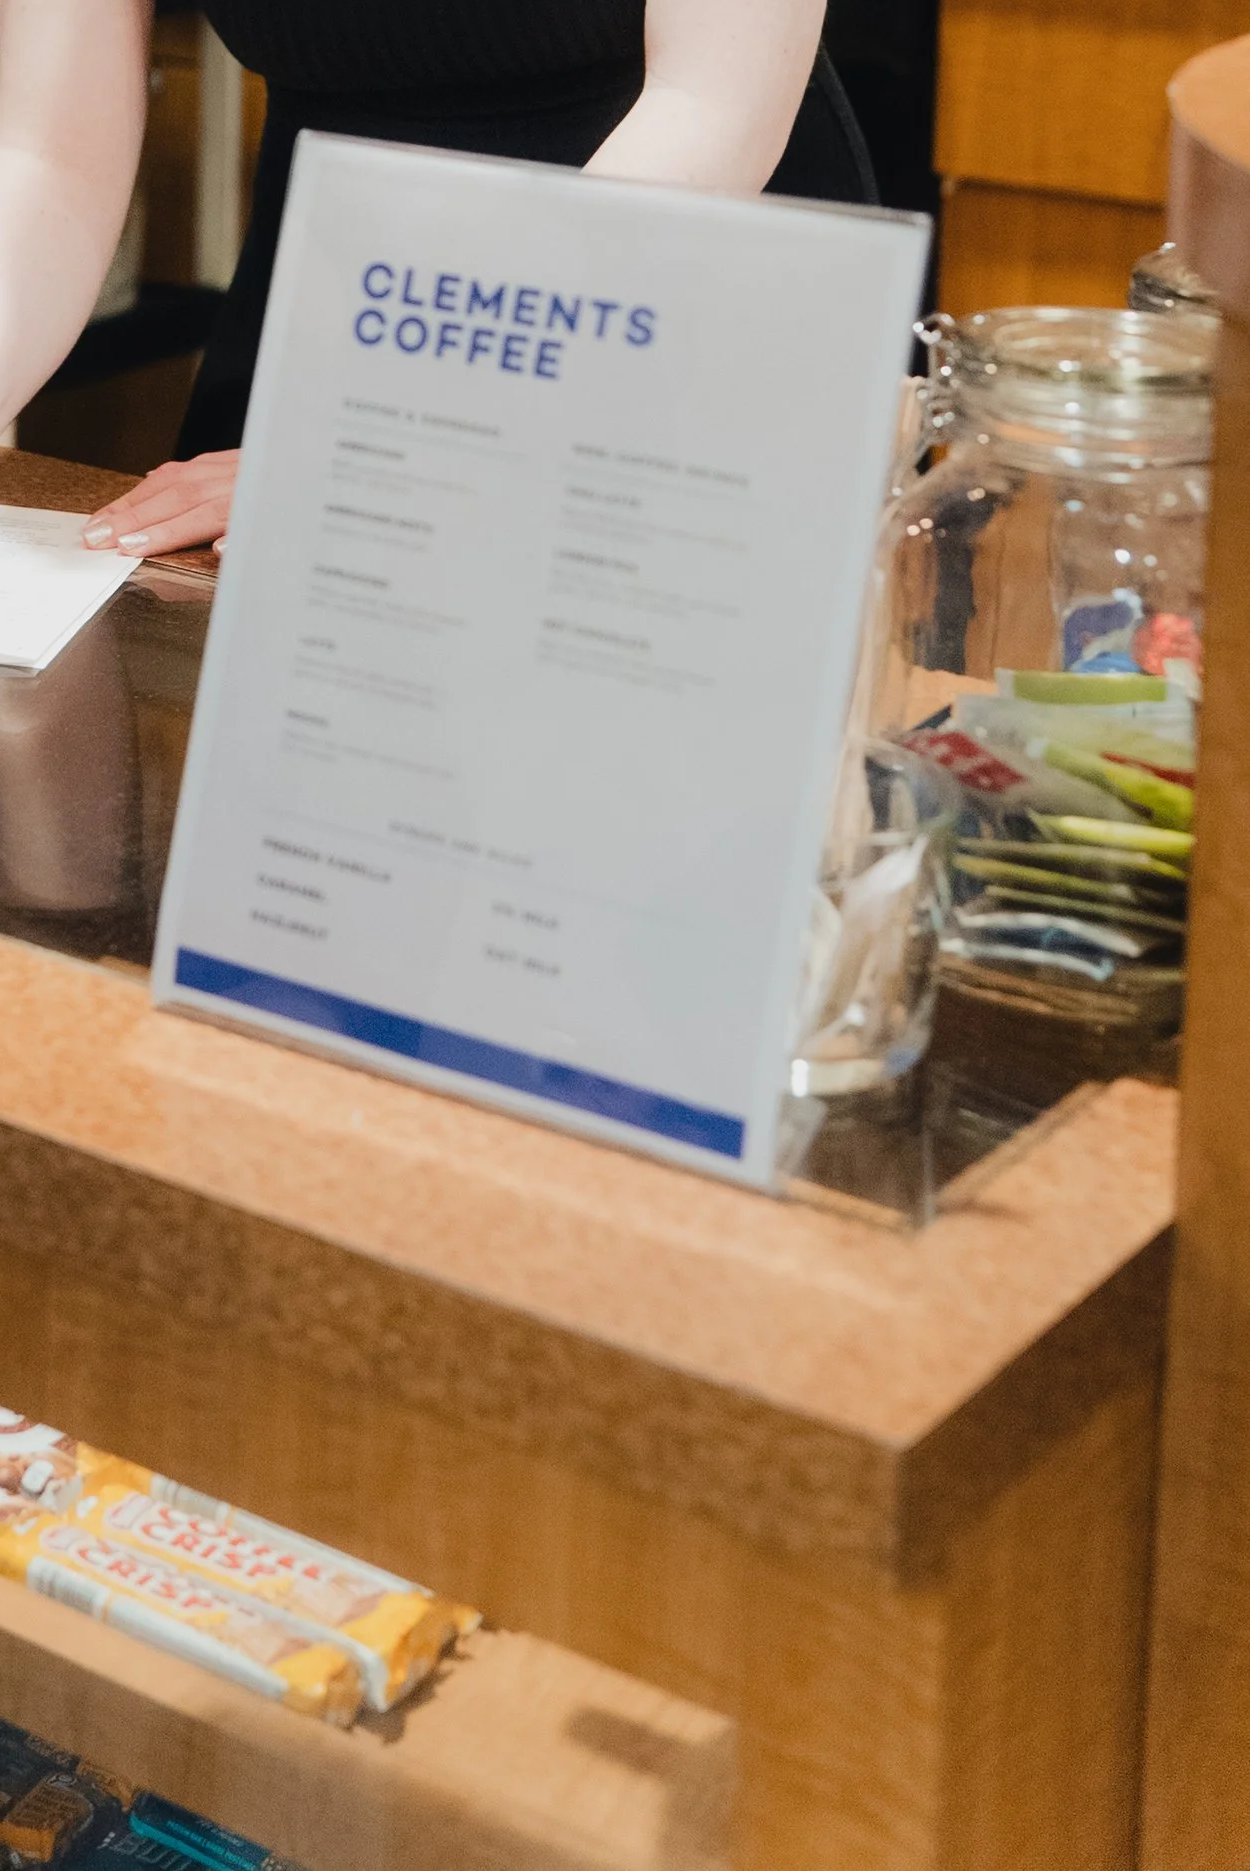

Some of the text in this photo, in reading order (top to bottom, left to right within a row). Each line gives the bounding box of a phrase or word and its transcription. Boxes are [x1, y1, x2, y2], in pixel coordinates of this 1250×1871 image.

[361, 262, 657, 347] CLEMENTS
[354, 308, 563, 380] COFFEE
[75, 1546, 216, 1610] CRISP
[138, 1521, 280, 1578] CRISP
